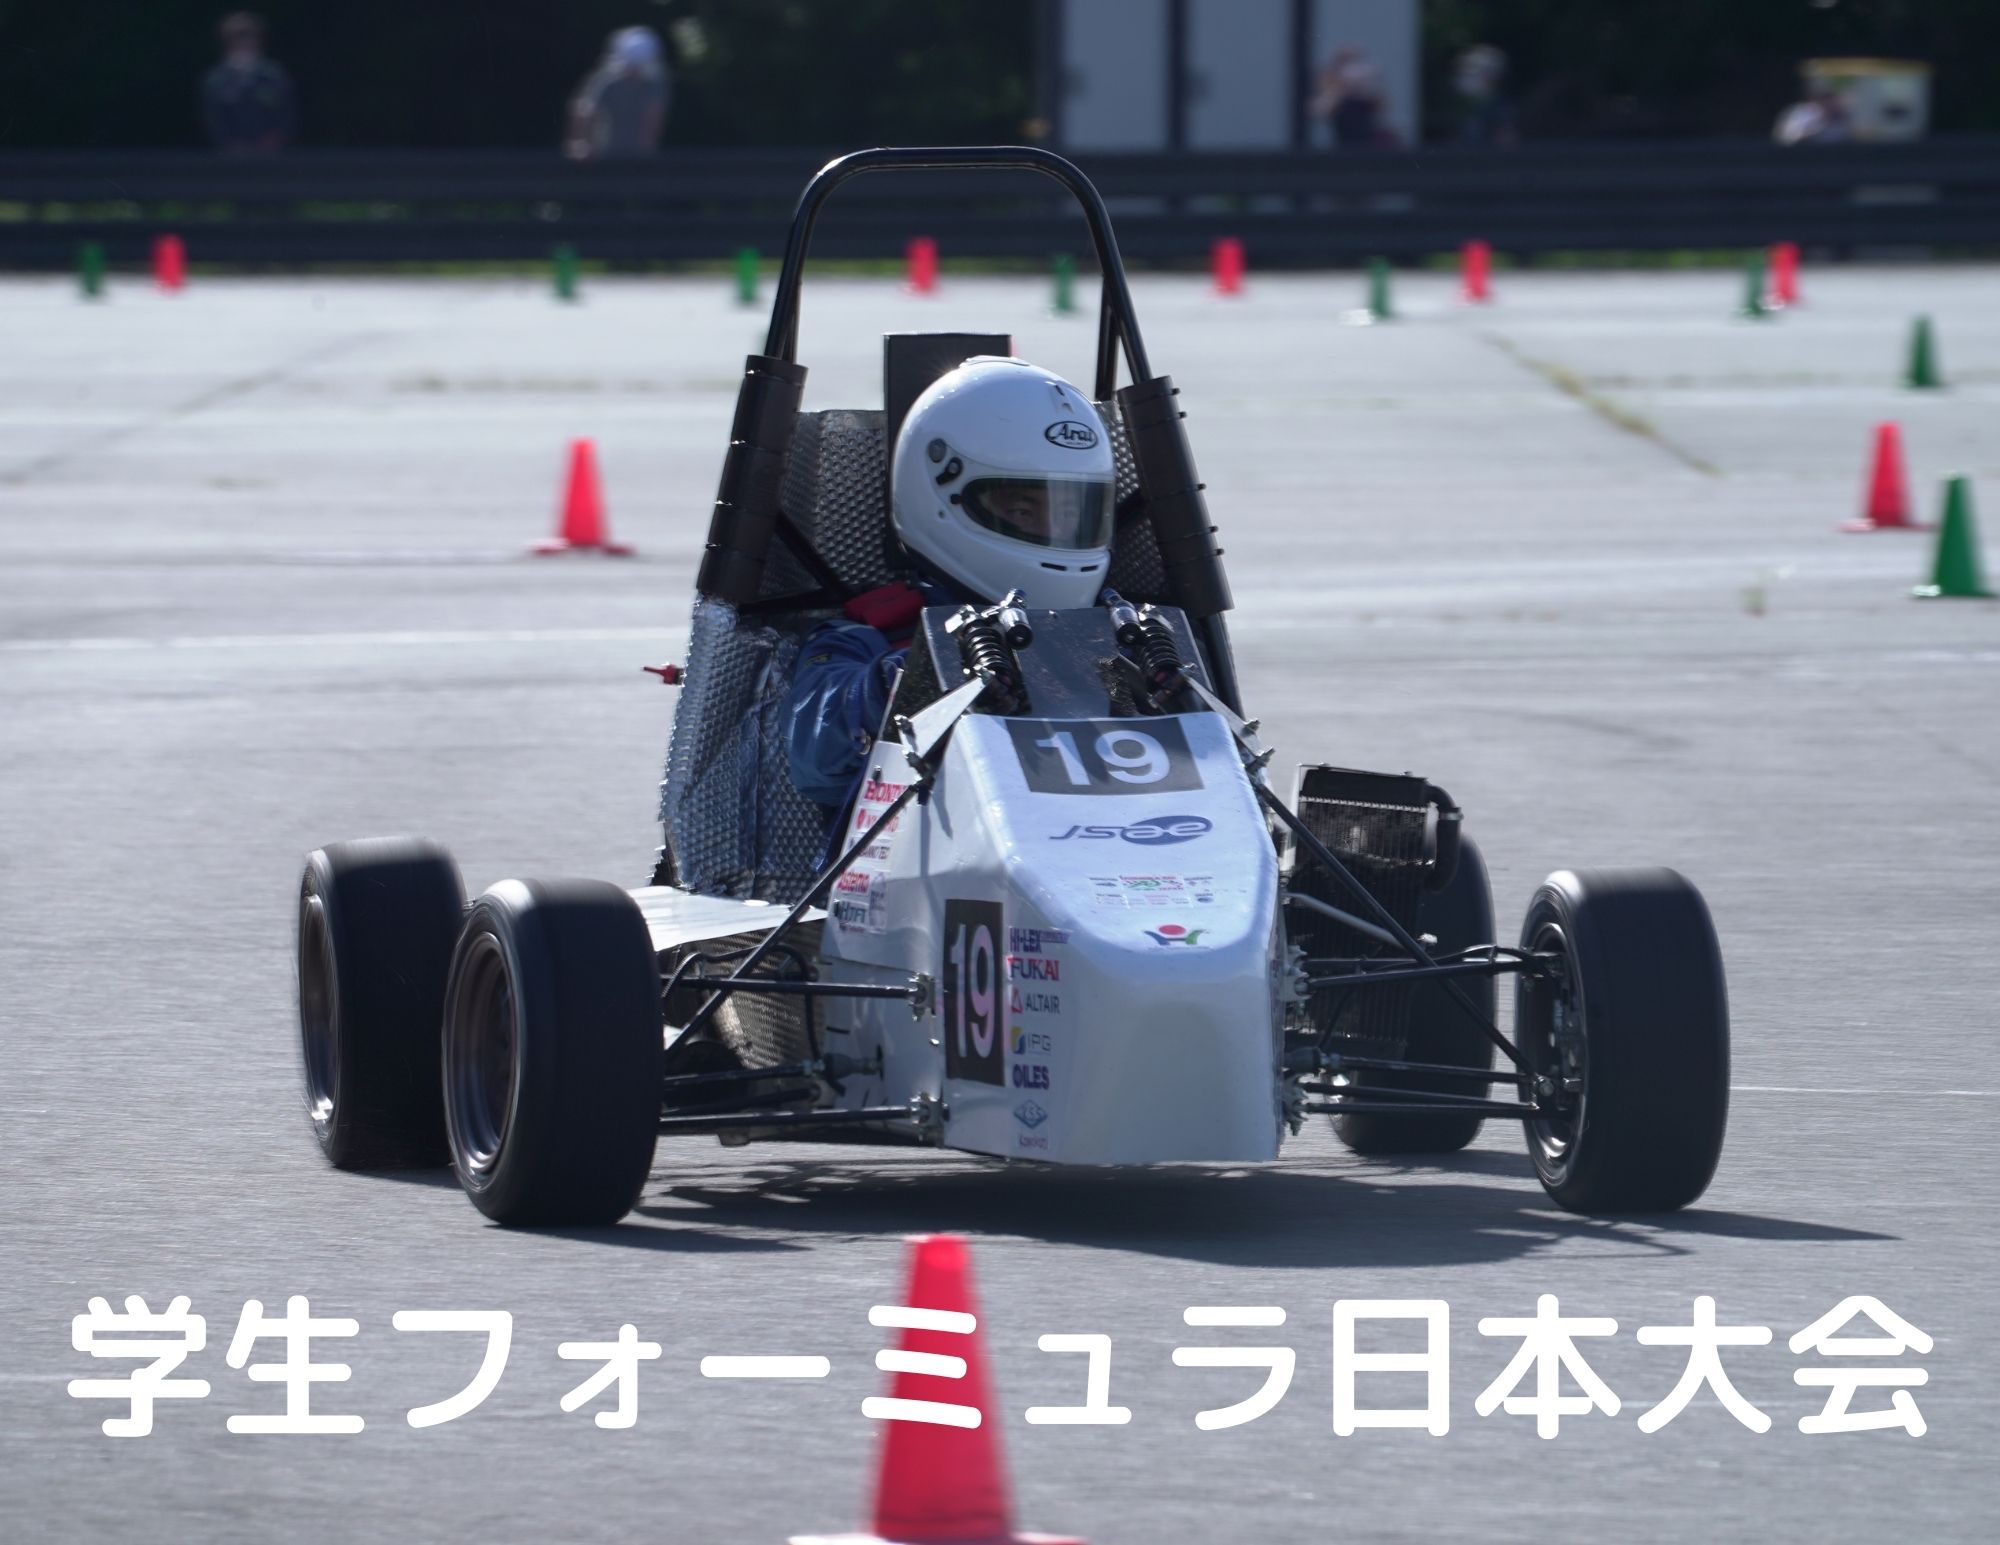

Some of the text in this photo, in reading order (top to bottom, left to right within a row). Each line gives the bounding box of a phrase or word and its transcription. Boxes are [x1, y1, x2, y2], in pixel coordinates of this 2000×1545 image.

[1052, 423, 1092, 441] Arai
[1035, 730, 1170, 786] 19
[864, 780, 908, 803] HOND
[1010, 928, 1042, 953] HI-LEX
[1008, 957, 1060, 981] FUKAI
[951, 924, 995, 1058] 19
[1026, 992, 1060, 1014] ALTAIR
[1027, 1033, 1051, 1051] IPG
[1012, 1064, 1049, 1090] OILES
